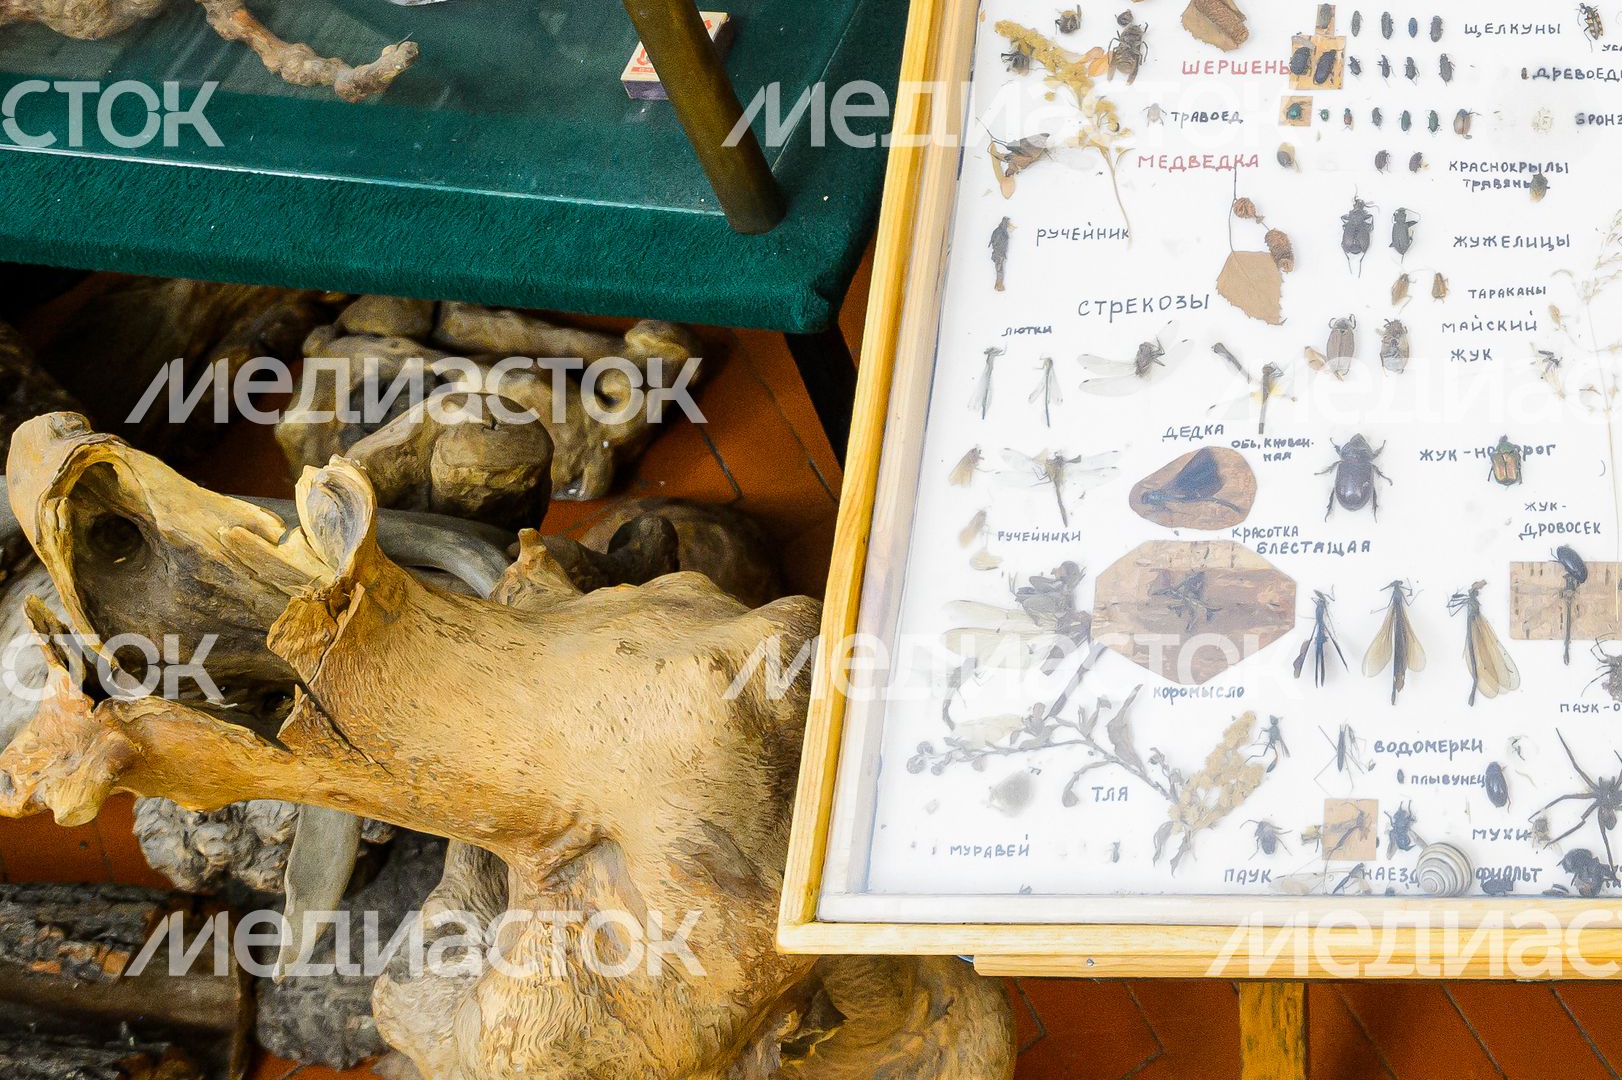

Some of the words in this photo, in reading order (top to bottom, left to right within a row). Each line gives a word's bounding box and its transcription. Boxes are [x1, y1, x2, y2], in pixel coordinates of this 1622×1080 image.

[1464, 22, 1562, 38] ЩЕЛКУНЫ
[1181, 59, 1290, 75] ШЕРШЕНЬ
[1137, 153, 1260, 173] МЕДВЕДКА
[1036, 222, 1130, 246] РУЧЕЙНИК
[1452, 234, 1571, 251] ЖУЖЕЛИЦЫ
[1468, 285, 1547, 300] ТАРАКАНЫ
[1077, 293, 1210, 324] СТРЕКОЗЫ
[1441, 309, 1539, 333] МАЙСКИЙ
[1450, 348, 1493, 362] ЖУК
[1161, 423, 1225, 442] ДЕДКА
[1231, 525, 1300, 540] КРАСОТКА
[1517, 522, 1601, 540] ДРОВОСЕК
[1091, 786, 1129, 802] ТЛЯ
[949, 834, 1030, 858] МУРАВЕЙ
[1224, 868, 1272, 884] ПАУК
